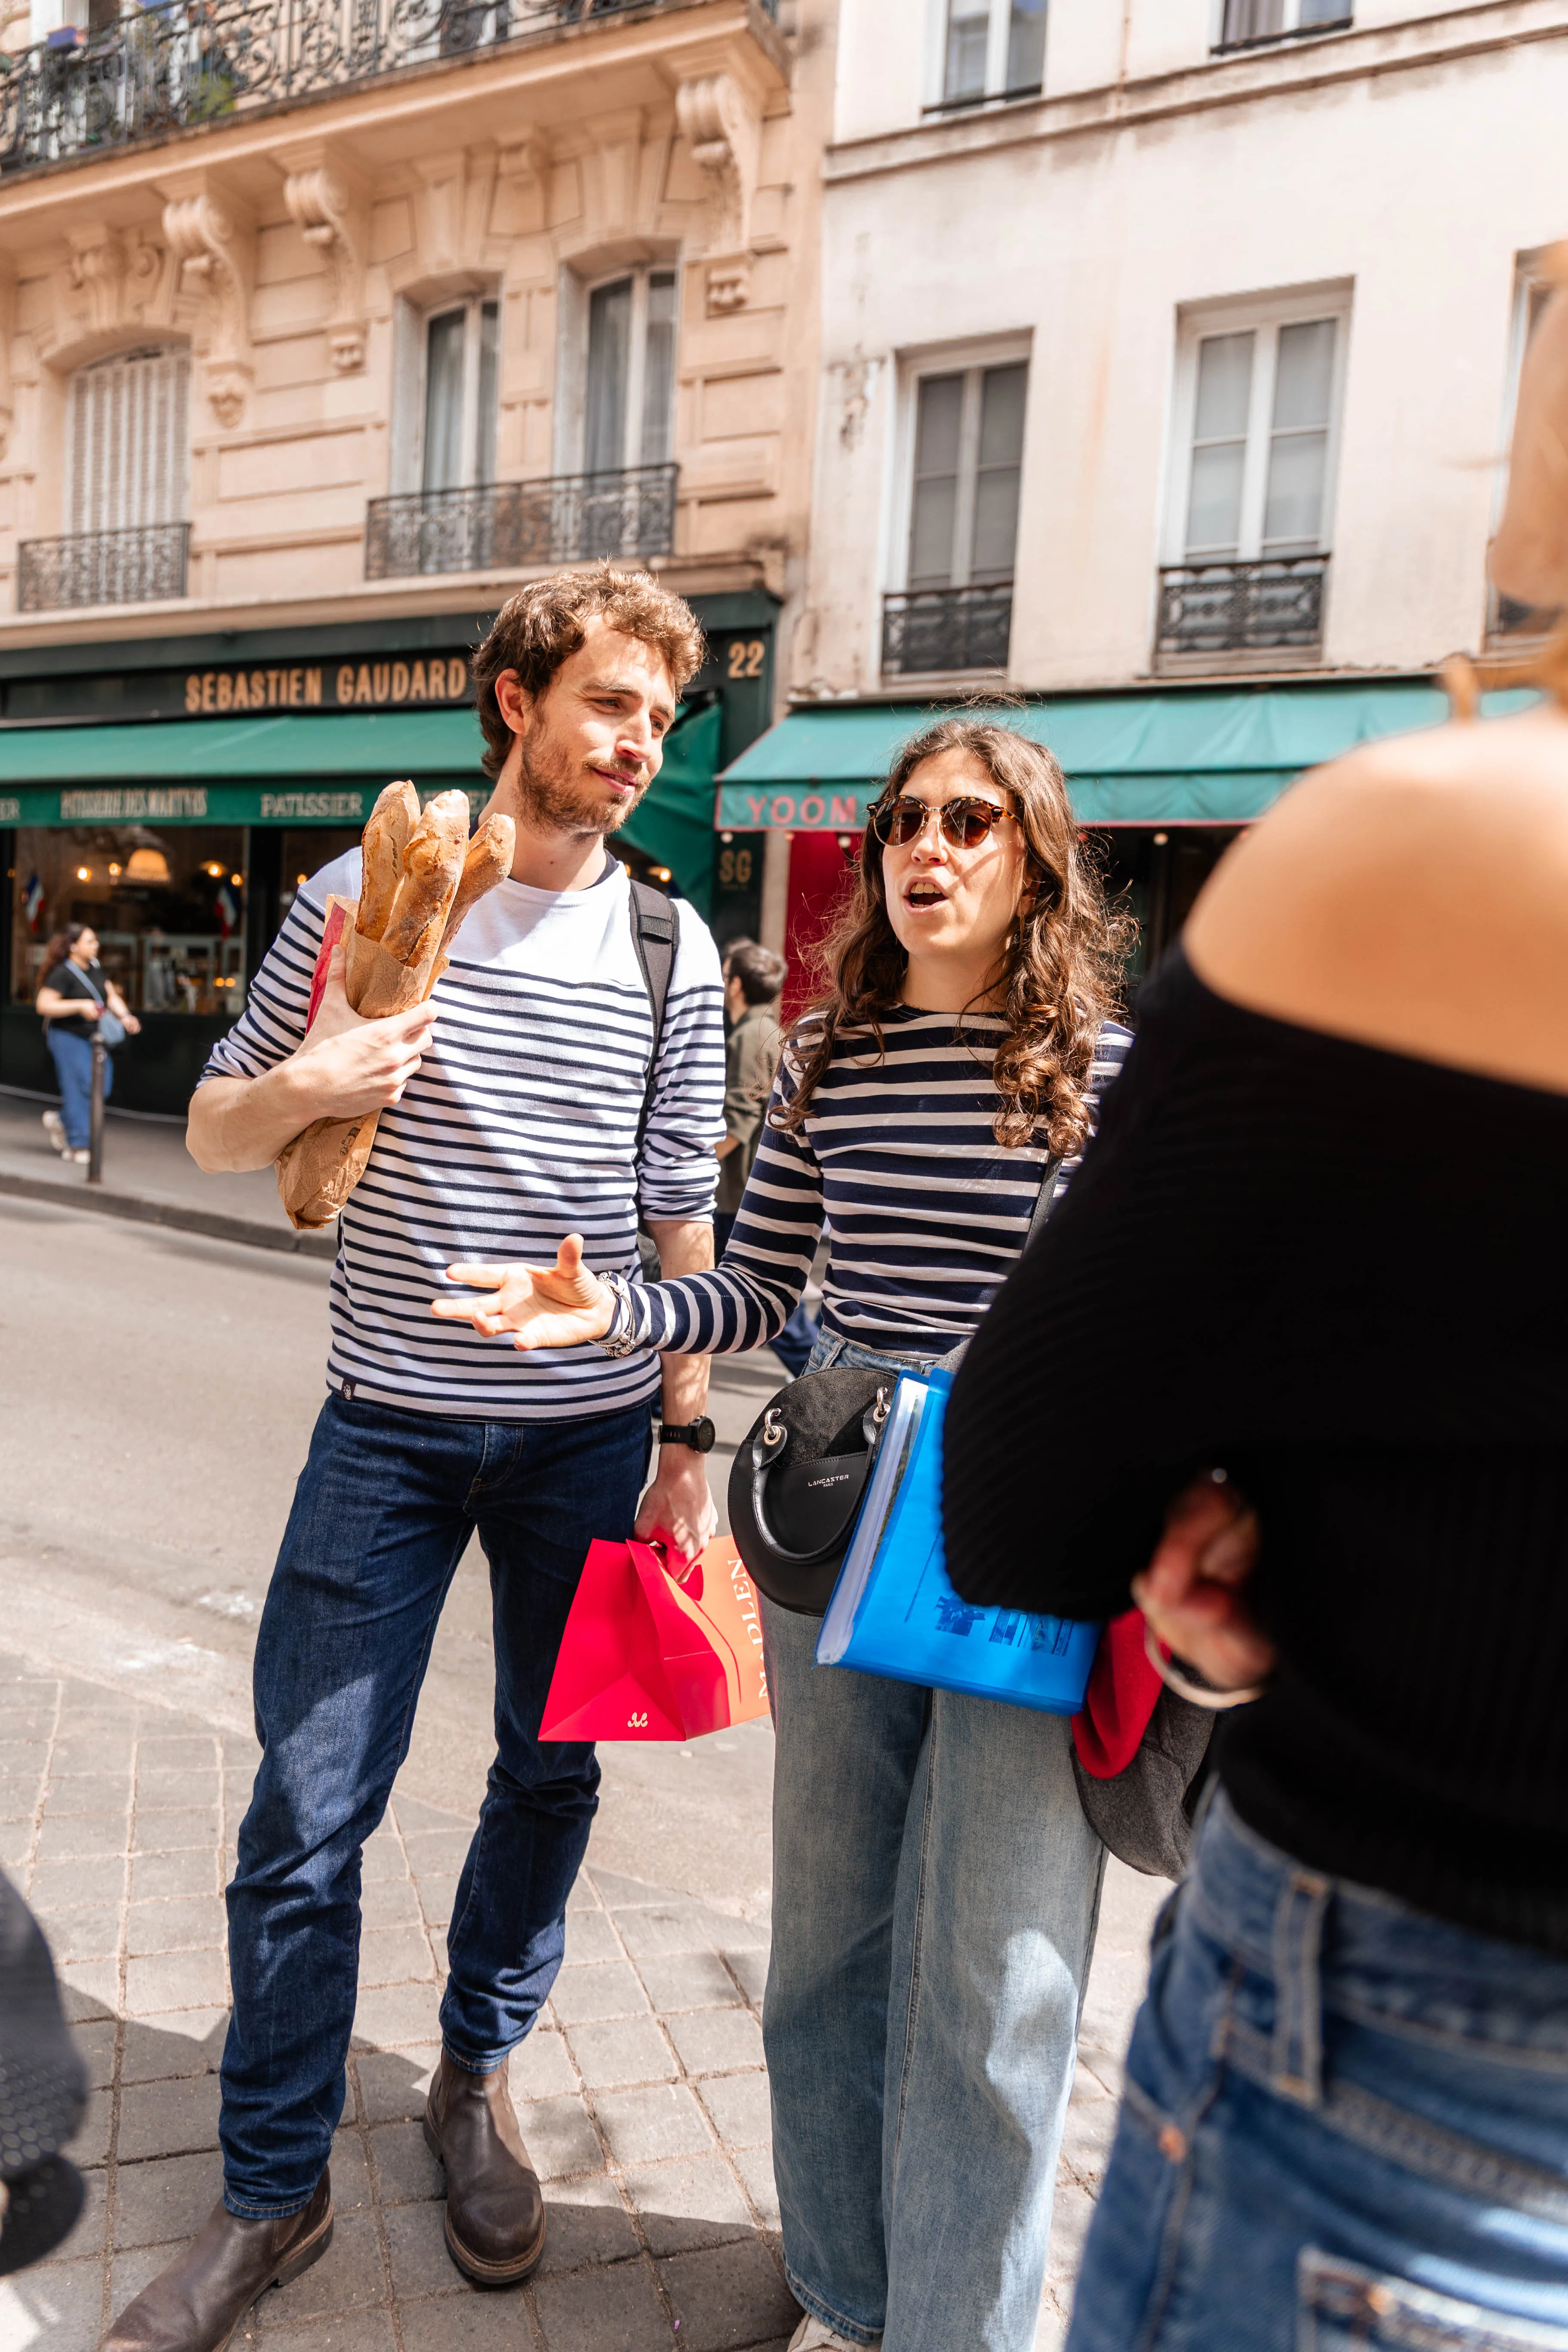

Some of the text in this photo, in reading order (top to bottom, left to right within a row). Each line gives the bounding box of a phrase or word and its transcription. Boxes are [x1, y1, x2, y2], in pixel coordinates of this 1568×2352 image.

[727, 640, 765, 679] 22
[184, 658, 466, 713] SEBASTIEN GAUDARD
[260, 792, 364, 818] PATISSIER
[746, 795, 858, 824] YOOM
[719, 849, 752, 882] SG
[808, 1474, 849, 1486] LANCASTER
